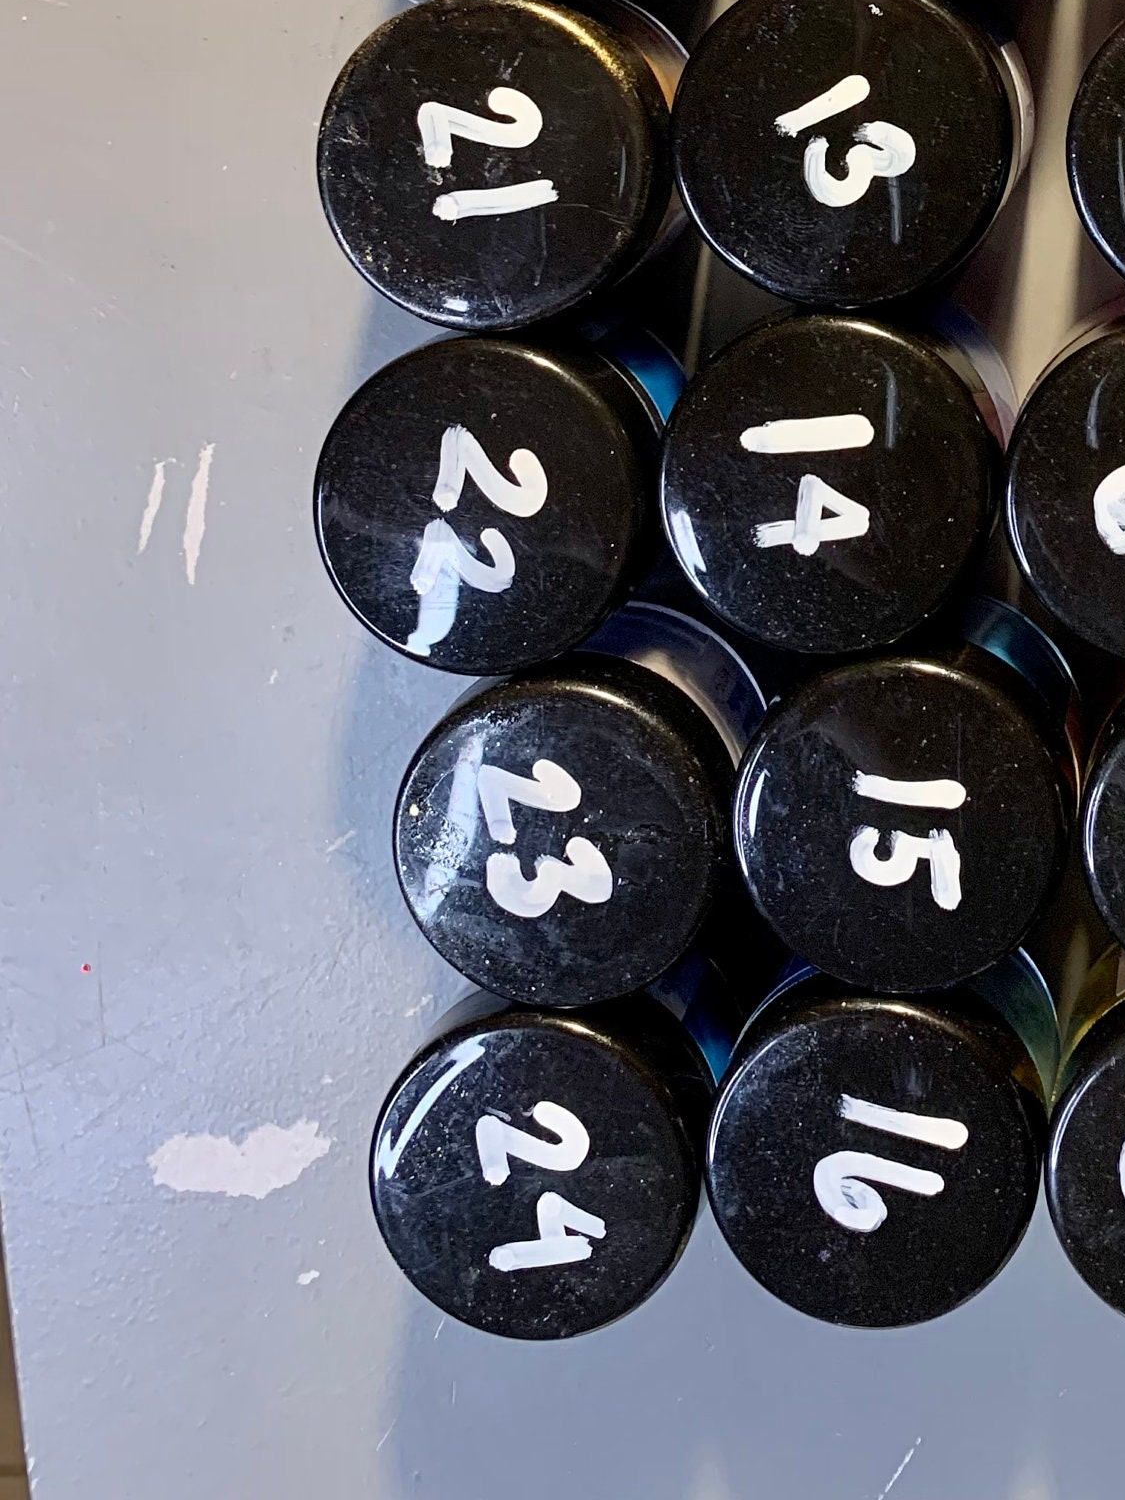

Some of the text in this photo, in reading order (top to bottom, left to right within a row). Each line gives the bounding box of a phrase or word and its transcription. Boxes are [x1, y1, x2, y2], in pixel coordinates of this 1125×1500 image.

[418, 87, 558, 220] 21
[774, 75, 915, 206] 13
[410, 424, 549, 594] 22
[740, 415, 874, 556] 14
[477, 758, 613, 918] 23
[850, 770, 966, 910] 15
[476, 1101, 606, 1271] 24
[814, 1094, 968, 1232] 16
